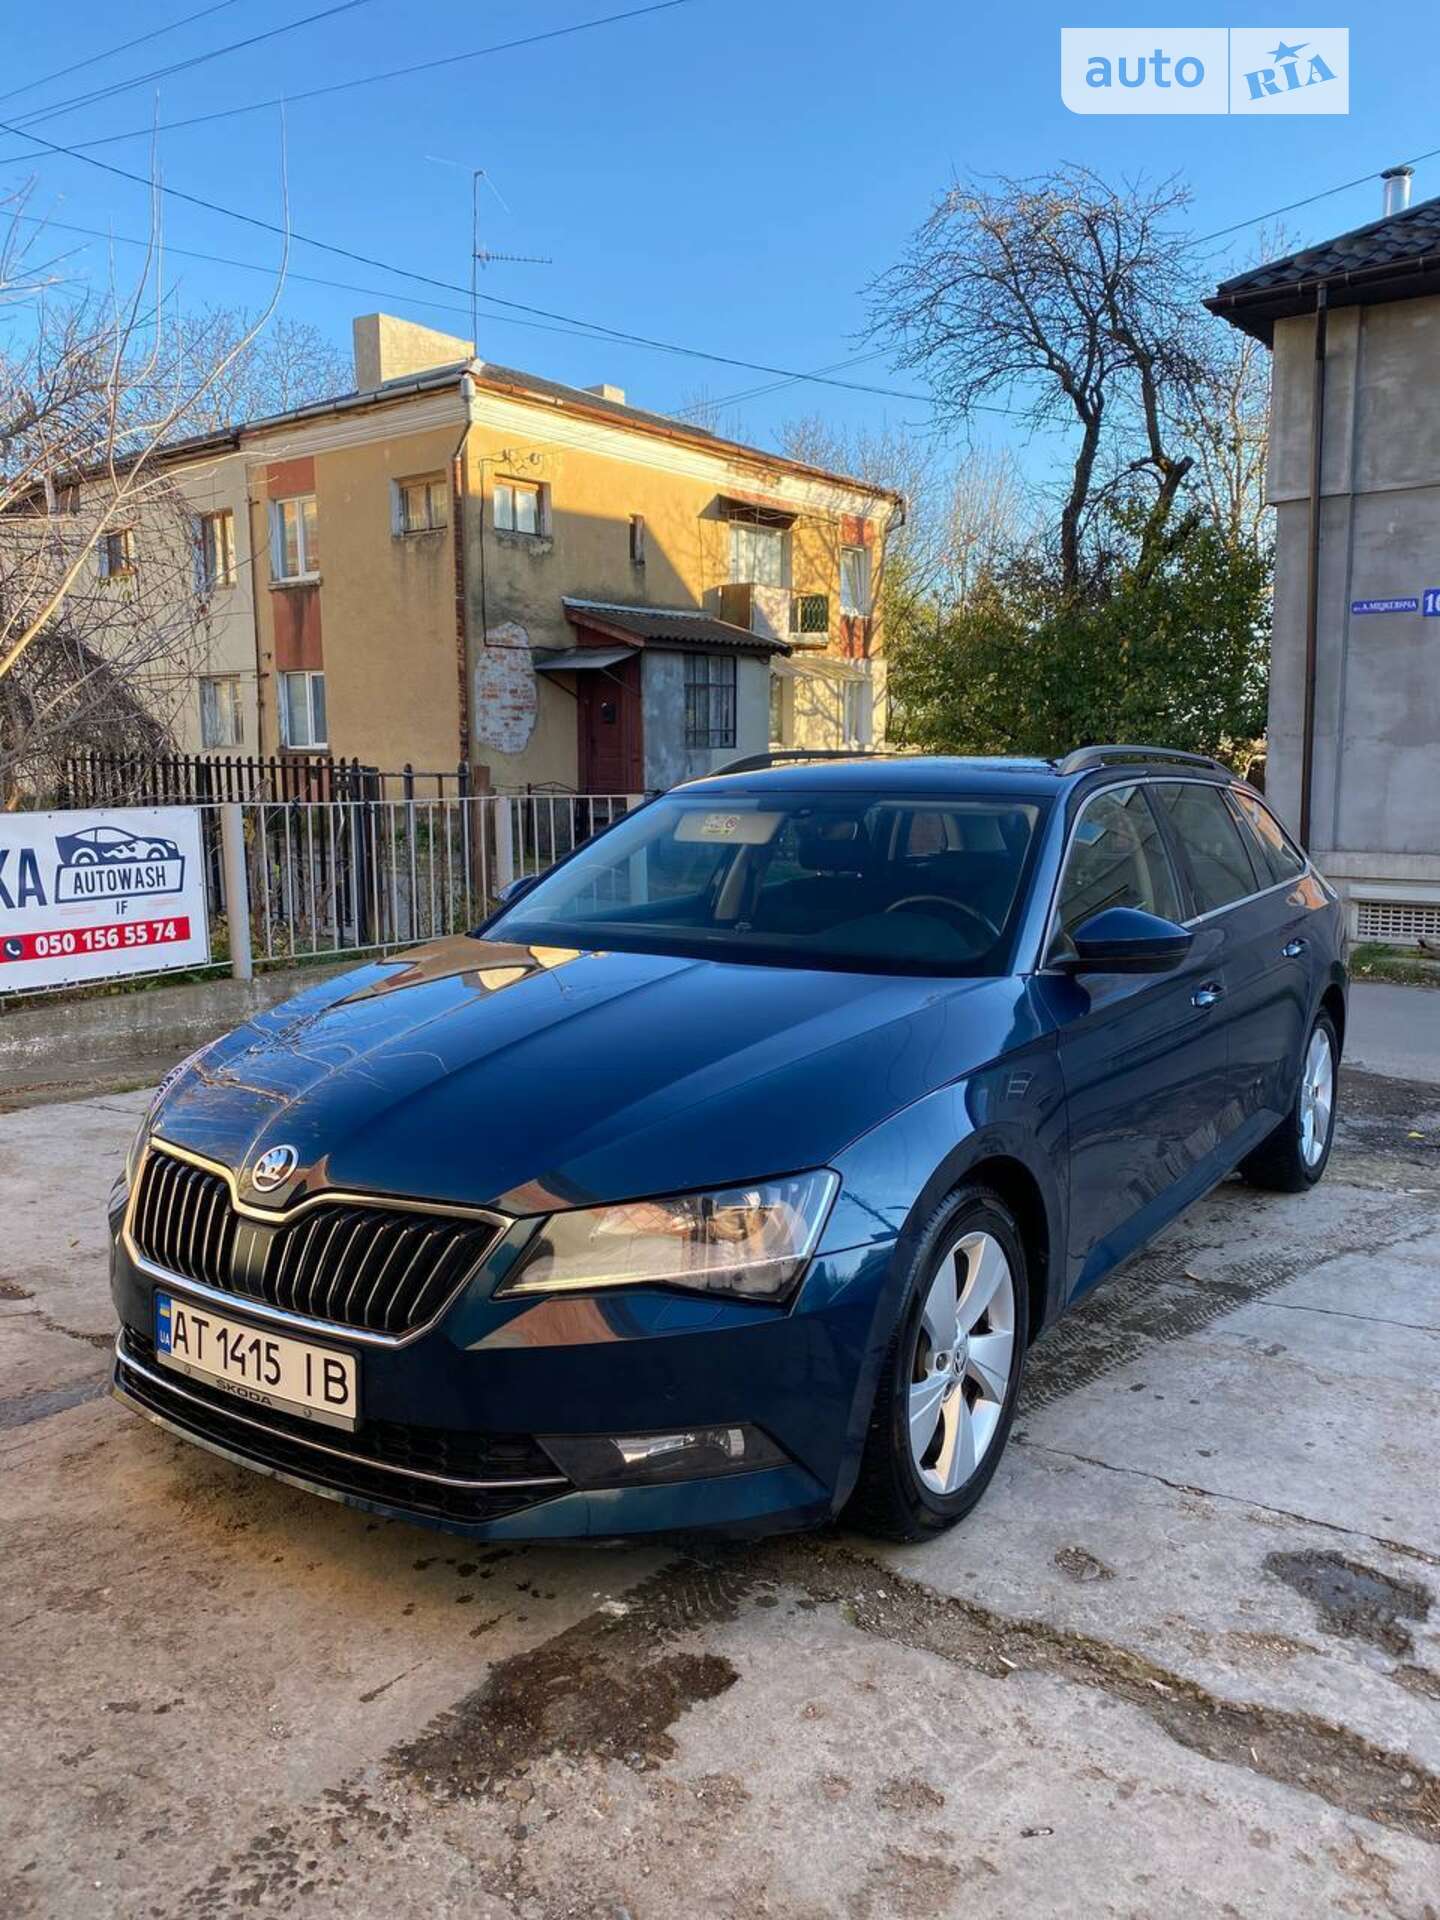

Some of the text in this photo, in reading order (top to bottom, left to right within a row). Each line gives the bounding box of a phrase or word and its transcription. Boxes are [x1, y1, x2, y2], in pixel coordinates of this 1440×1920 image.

[73, 865, 167, 895] AUTOWASH
[115, 900, 128, 915] IF
[35, 920, 176, 956] 050 156 55 74
[159, 1330, 170, 1347] UA
[173, 1310, 349, 1406] AT 1415 IB
